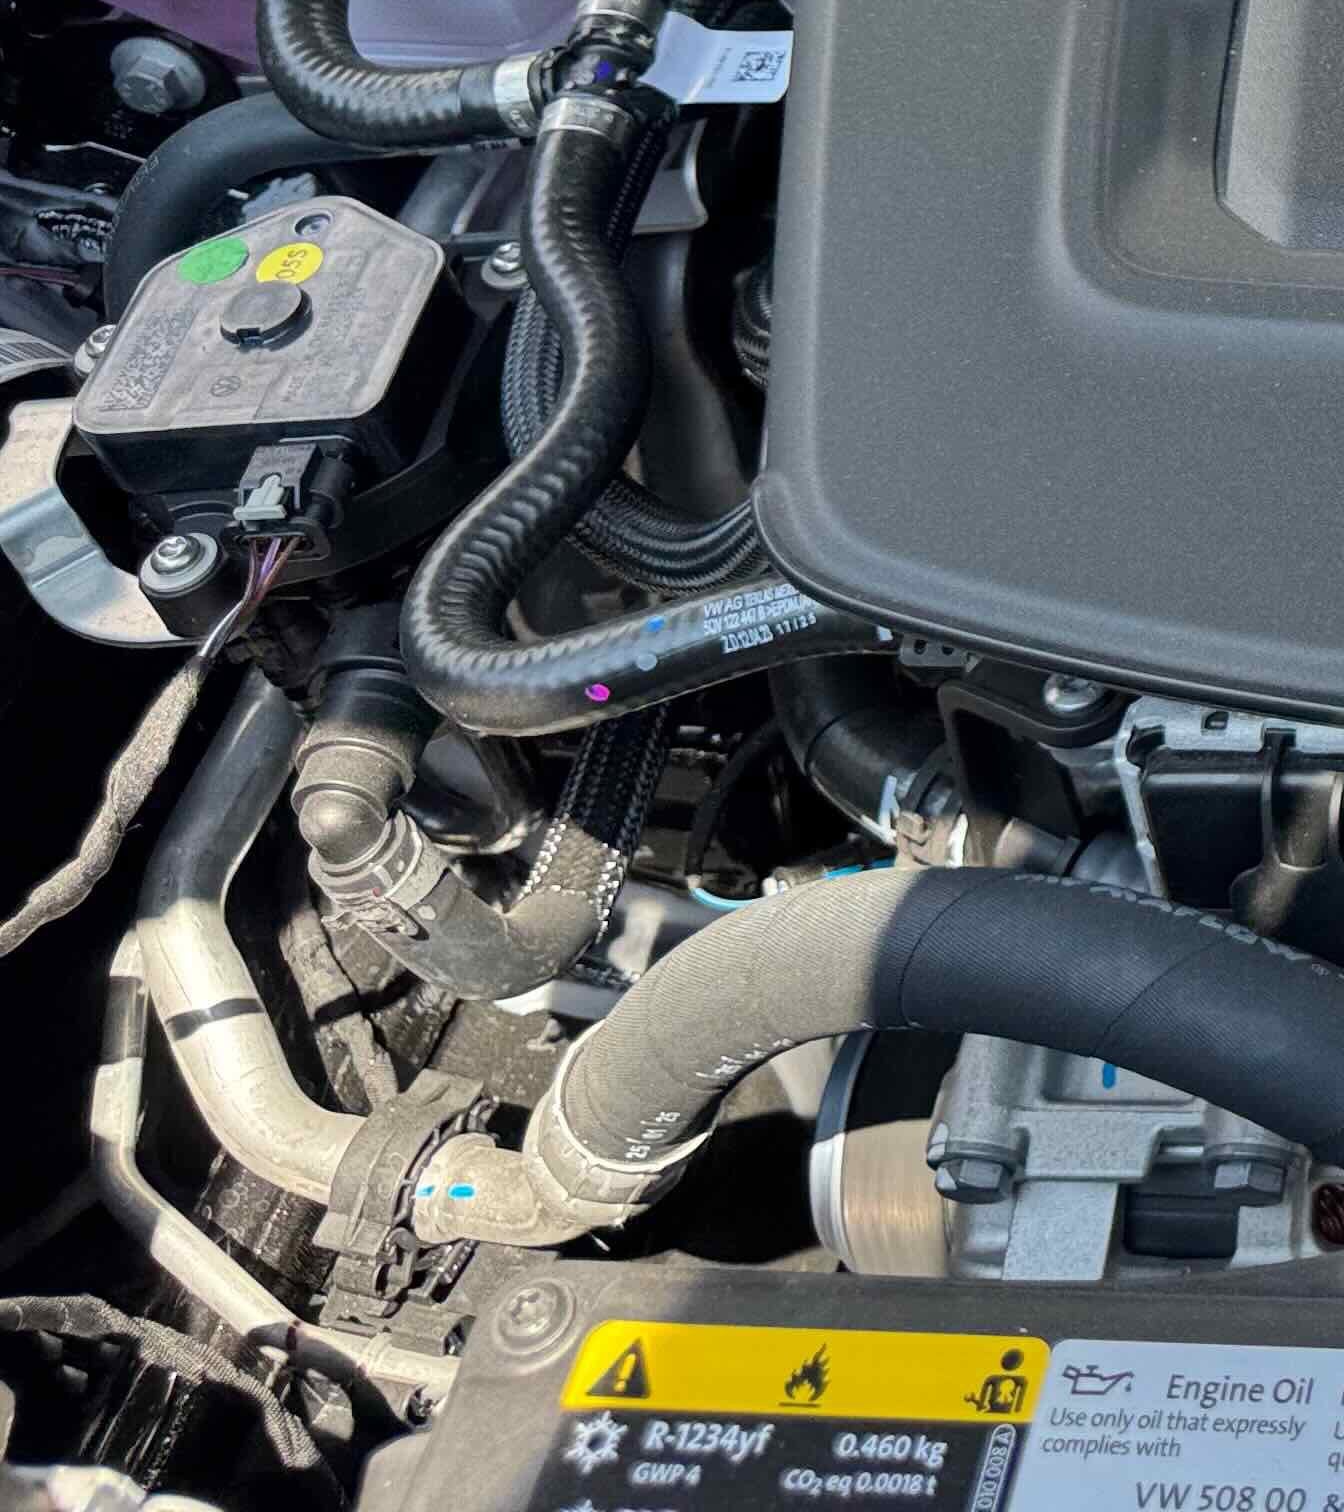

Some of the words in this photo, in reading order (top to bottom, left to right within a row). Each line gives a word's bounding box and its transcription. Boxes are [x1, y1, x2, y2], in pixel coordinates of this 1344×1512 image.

[1166, 1373, 1265, 1409] Engine
[1272, 1377, 1315, 1406] Oil
[995, 1431, 1013, 1445] A
[1049, 1408, 1087, 1428] Use
[1091, 1409, 1134, 1434] only
[1138, 1411, 1162, 1431] oil
[1167, 1412, 1208, 1433] that
[1212, 1413, 1307, 1441] expressly
[644, 1421, 775, 1462] R-1234yf
[835, 1432, 910, 1462] 0.460
[912, 1437, 948, 1467] kg
[1042, 1435, 1131, 1460] complies
[1136, 1437, 1182, 1458] with
[632, 1461, 684, 1485] GWP
[685, 1463, 702, 1485] 4
[825, 1474, 853, 1498] eq
[855, 1471, 923, 1495] 0.0018
[925, 1473, 938, 1496] t
[1136, 1481, 1193, 1510] VW
[1197, 1484, 1257, 1512] 508
[1264, 1487, 1307, 1512] 00
